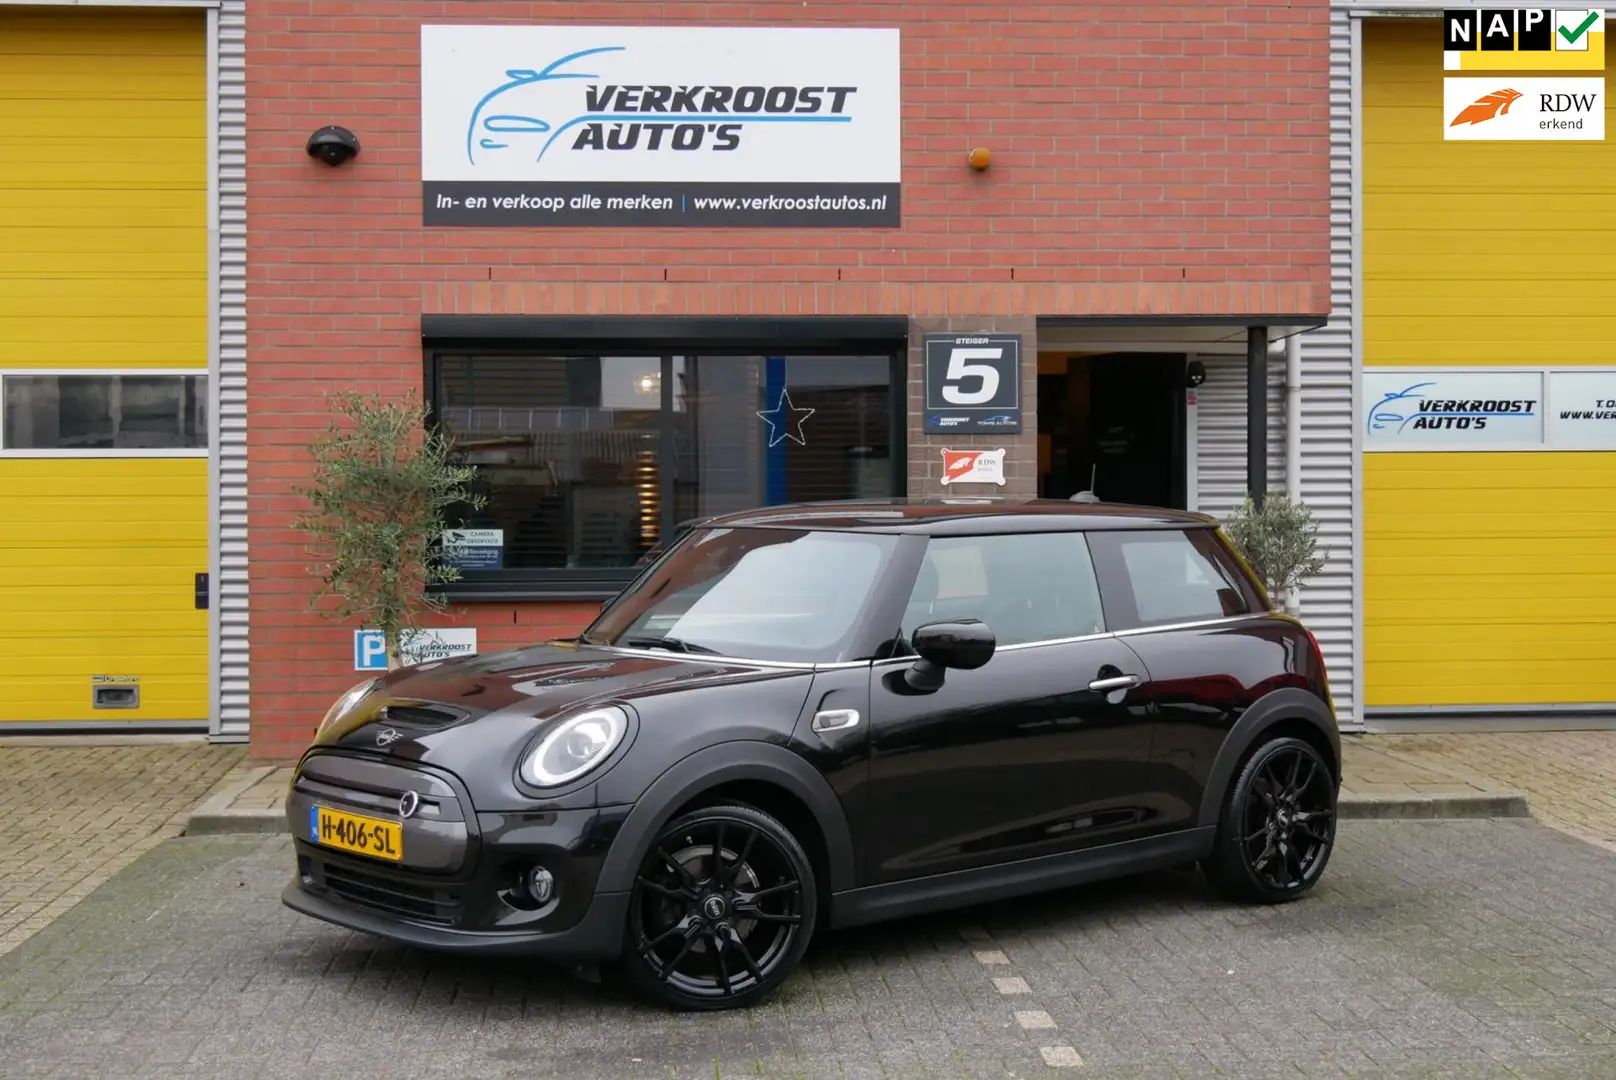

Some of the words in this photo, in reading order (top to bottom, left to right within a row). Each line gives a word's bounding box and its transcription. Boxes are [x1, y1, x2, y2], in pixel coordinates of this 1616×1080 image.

[585, 85, 858, 113] VERKROOST
[571, 123, 743, 150] AUTO'S
[436, 194, 460, 209] In-
[465, 196, 488, 209] en
[493, 194, 565, 212] verkoop
[570, 194, 602, 209] alle
[606, 194, 673, 210] merken
[694, 195, 887, 211] www.verkroostautos.nl
[955, 337, 989, 345] STEIGER
[942, 348, 1003, 405] 5
[1419, 399, 1537, 413] VERKROOST
[1413, 416, 1488, 430] AUTO'S
[363, 635, 386, 666] P
[322, 814, 396, 855] H-406-SL
